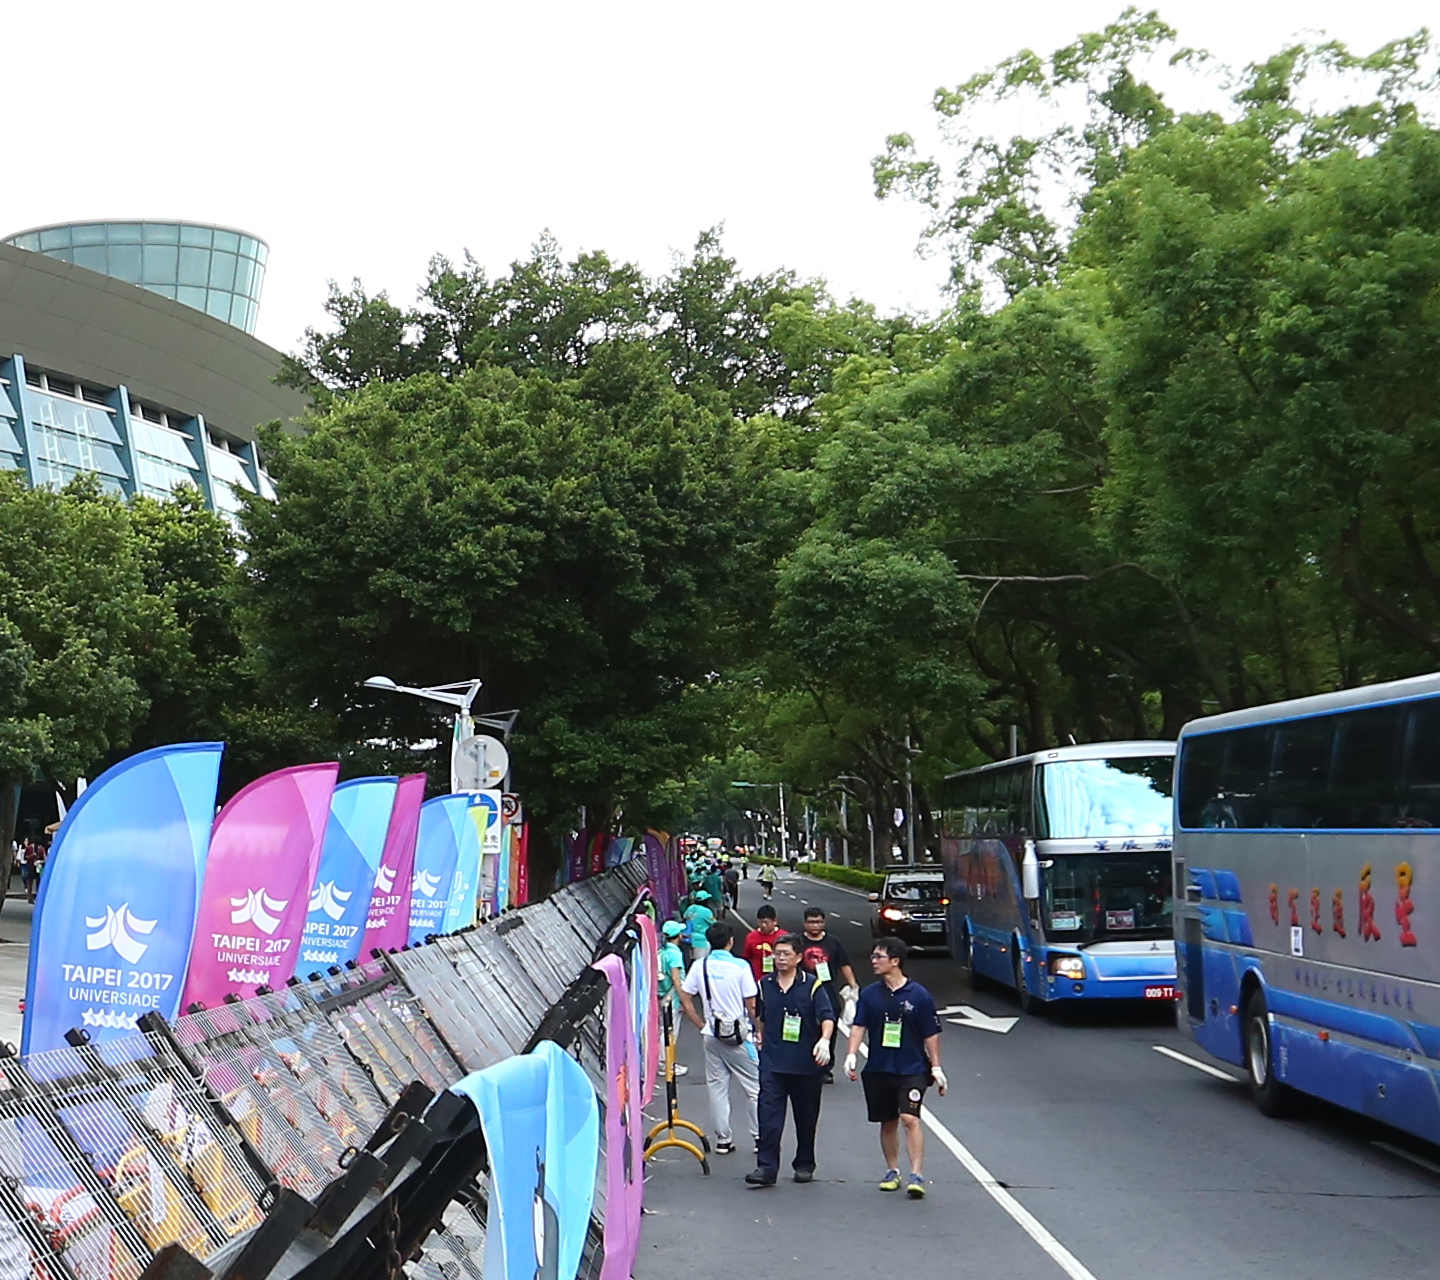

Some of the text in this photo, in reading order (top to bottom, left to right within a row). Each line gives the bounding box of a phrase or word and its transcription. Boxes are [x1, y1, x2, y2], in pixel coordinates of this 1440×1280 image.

[332, 924, 359, 938] 2017
[211, 933, 261, 952] TAIPEI
[300, 935, 349, 949] NIVERSIADE
[61, 964, 174, 991] TAIPEI 2017
[69, 987, 161, 1009] UNIVERSIADE
